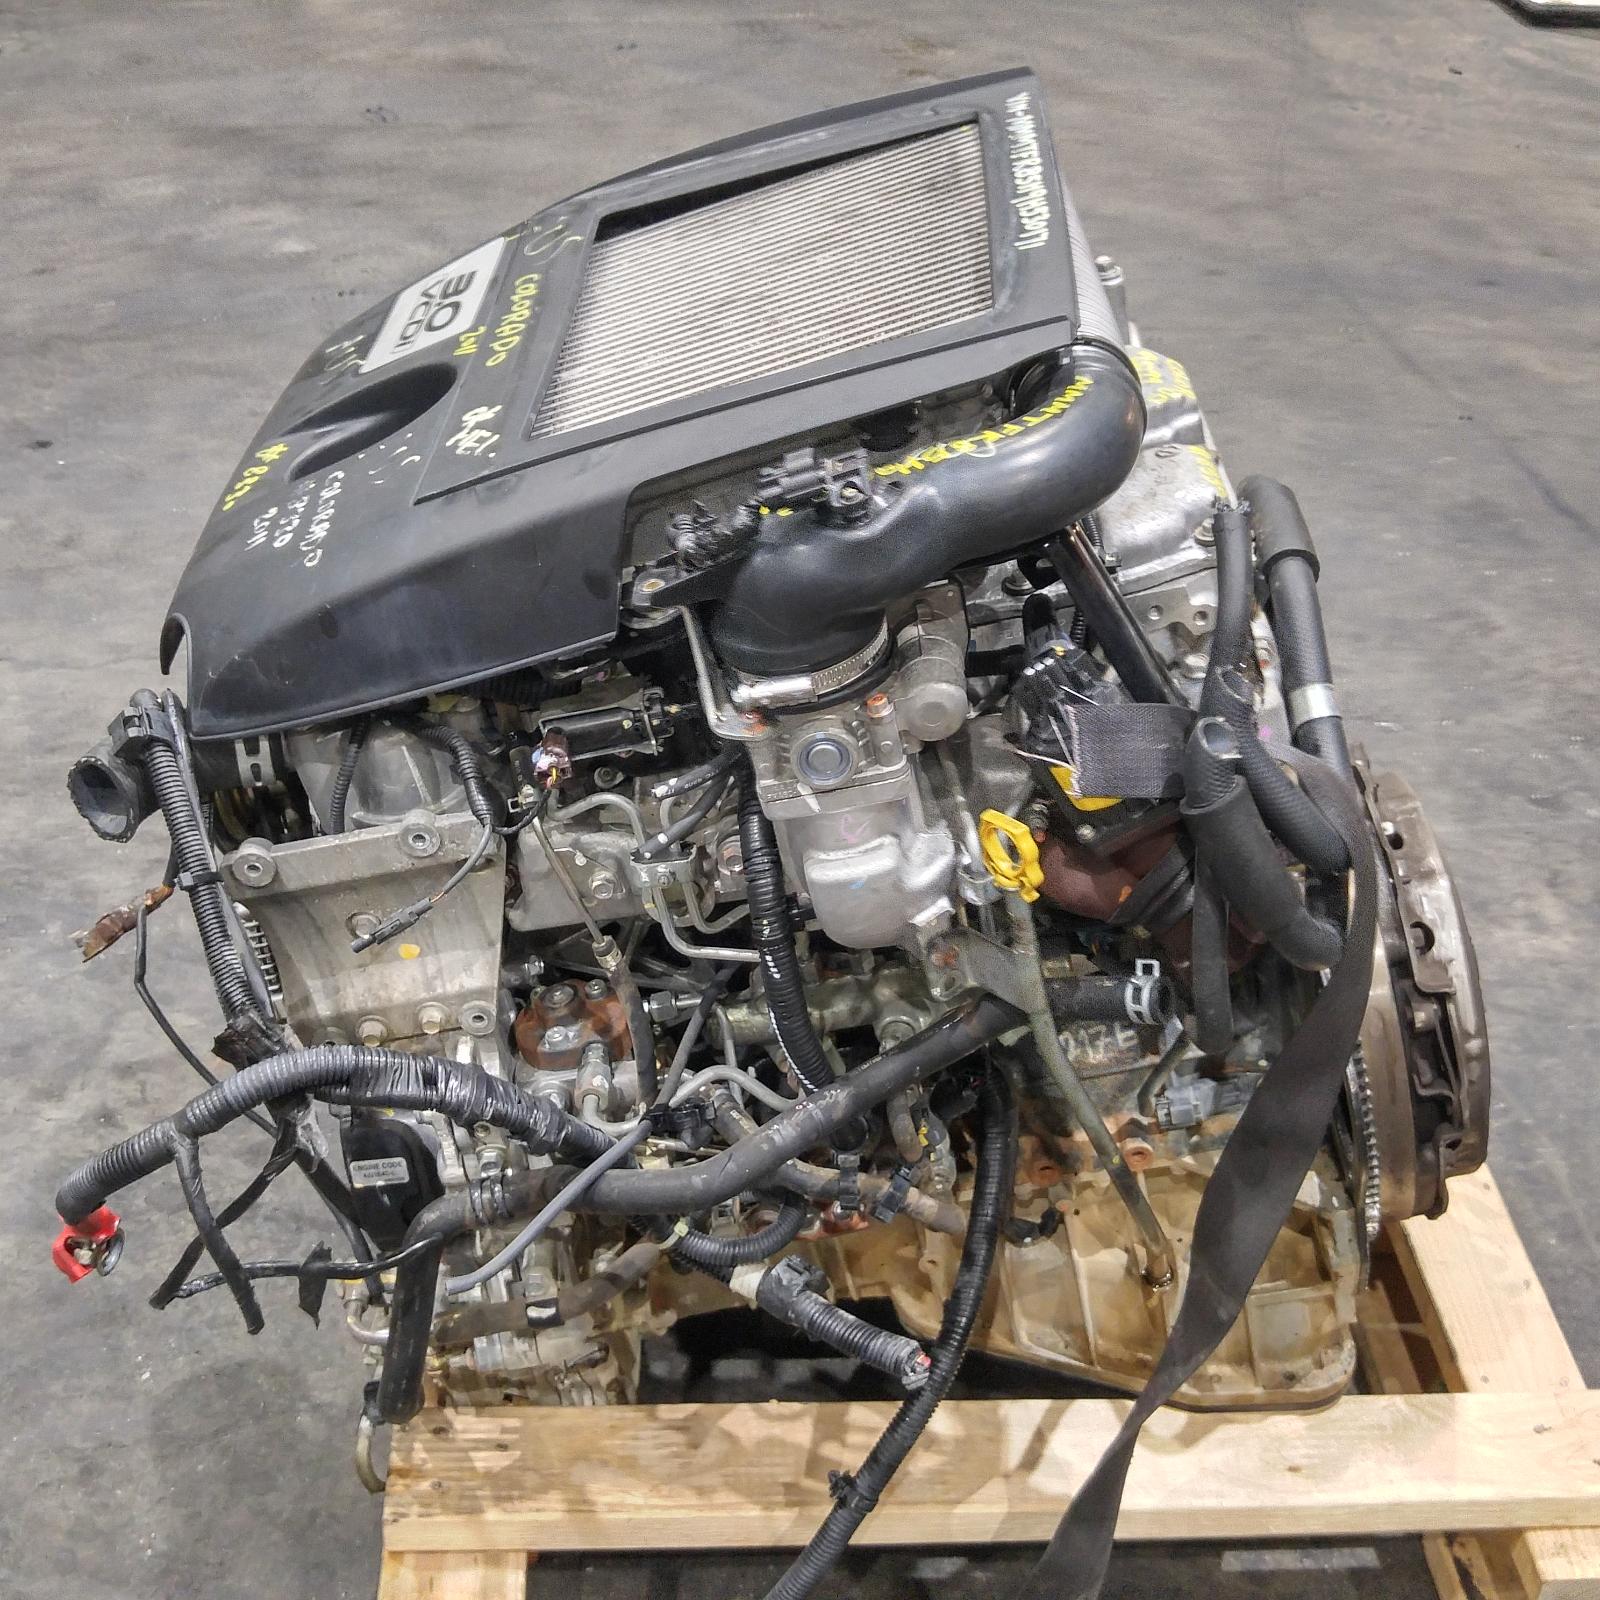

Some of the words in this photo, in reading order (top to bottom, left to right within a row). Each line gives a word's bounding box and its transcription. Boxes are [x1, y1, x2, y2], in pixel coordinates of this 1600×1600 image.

[423, 269, 479, 333] 3.0
[485, 273, 542, 367] COLORADO
[453, 326, 487, 356] 2011
[300, 470, 345, 567] COLORADO
